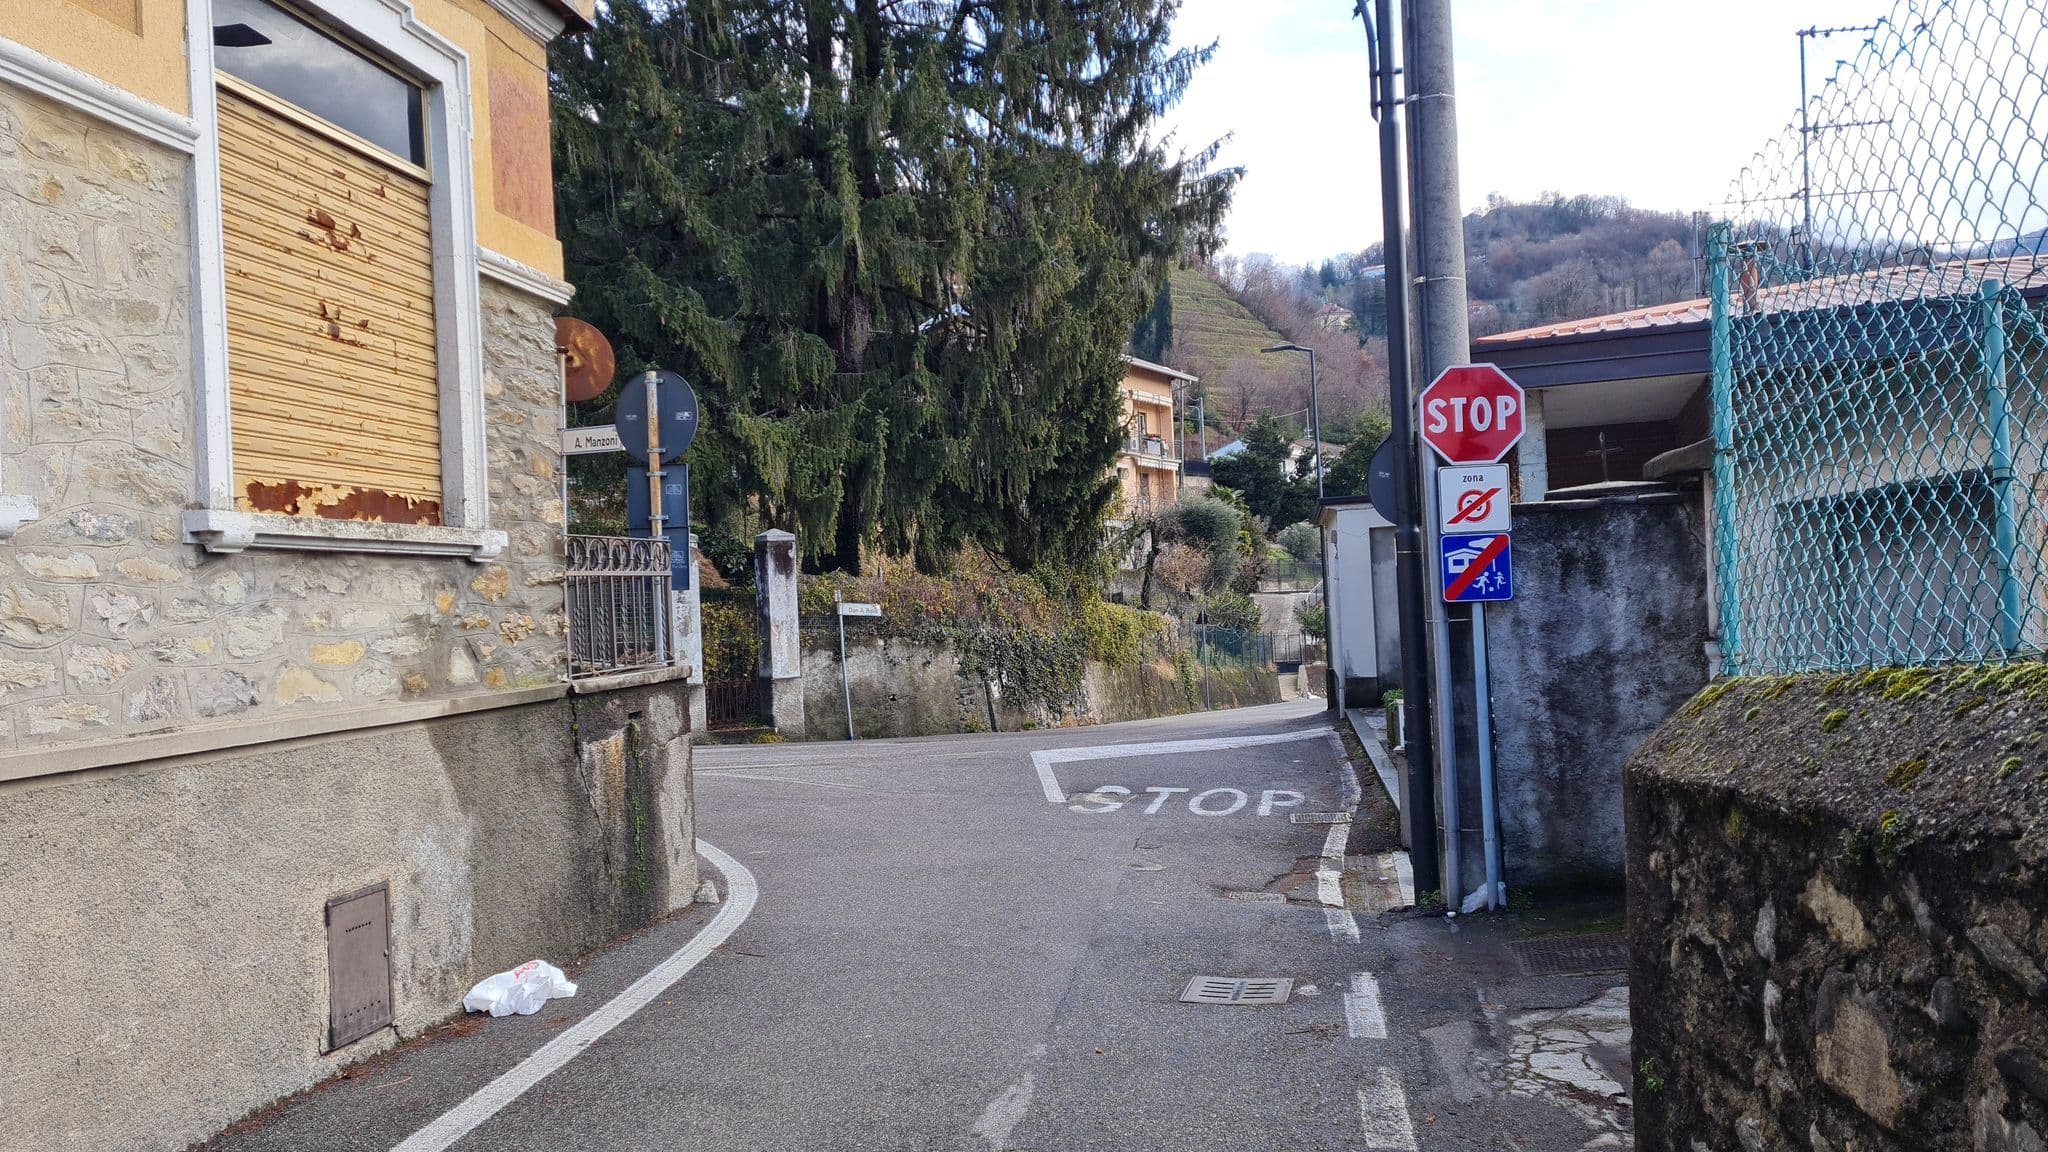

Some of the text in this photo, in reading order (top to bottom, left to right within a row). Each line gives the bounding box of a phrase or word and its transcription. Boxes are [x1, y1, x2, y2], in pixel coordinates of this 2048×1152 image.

[1427, 395, 1517, 434] STOP
[586, 435, 618, 449] Manzoni
[1462, 474, 1484, 483] zona
[1069, 785, 1305, 817] STOP
